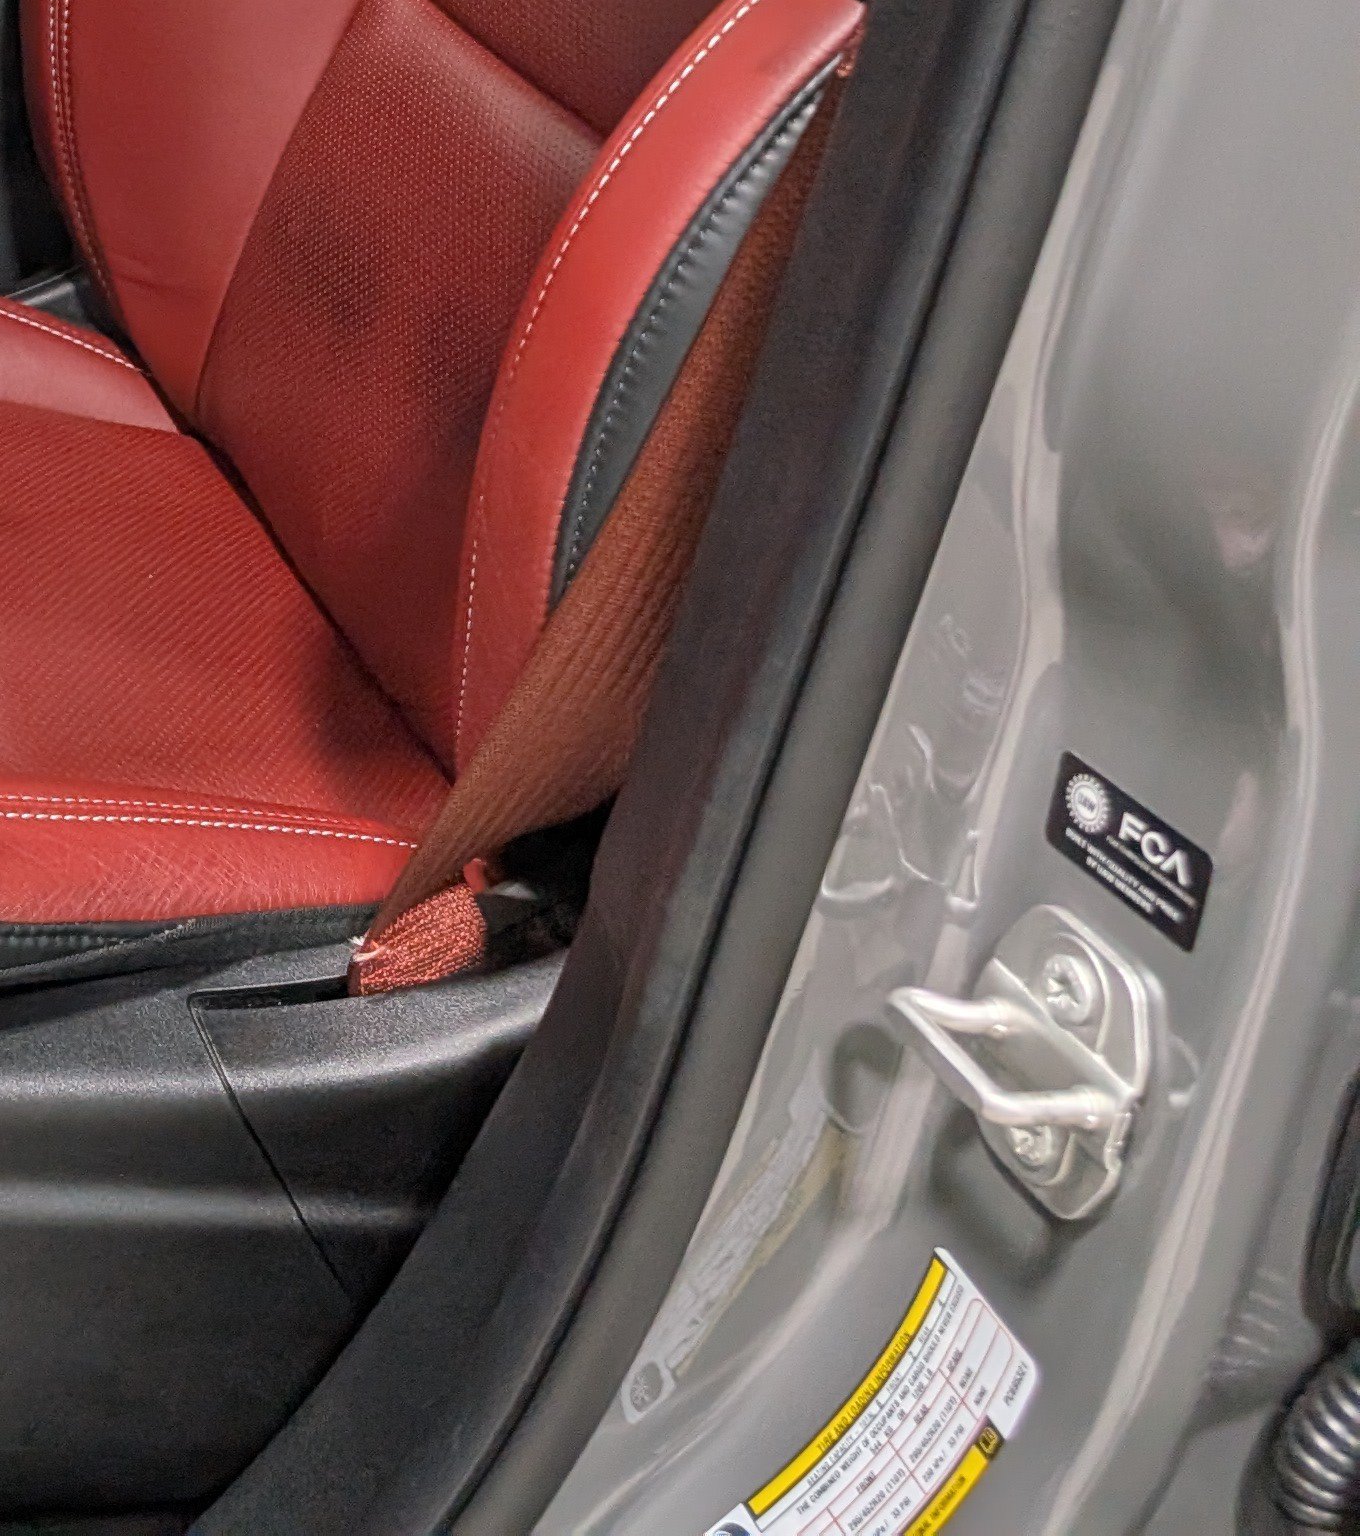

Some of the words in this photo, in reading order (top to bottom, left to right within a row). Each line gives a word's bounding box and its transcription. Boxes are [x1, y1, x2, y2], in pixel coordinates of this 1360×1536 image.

[1118, 812, 1191, 887] FCA
[816, 1432, 835, 1453] TIRE
[833, 1415, 851, 1437] AND
[847, 1384, 876, 1418] LOADING
[873, 1331, 913, 1388] INFORMATION
[796, 1499, 810, 1515] THE
